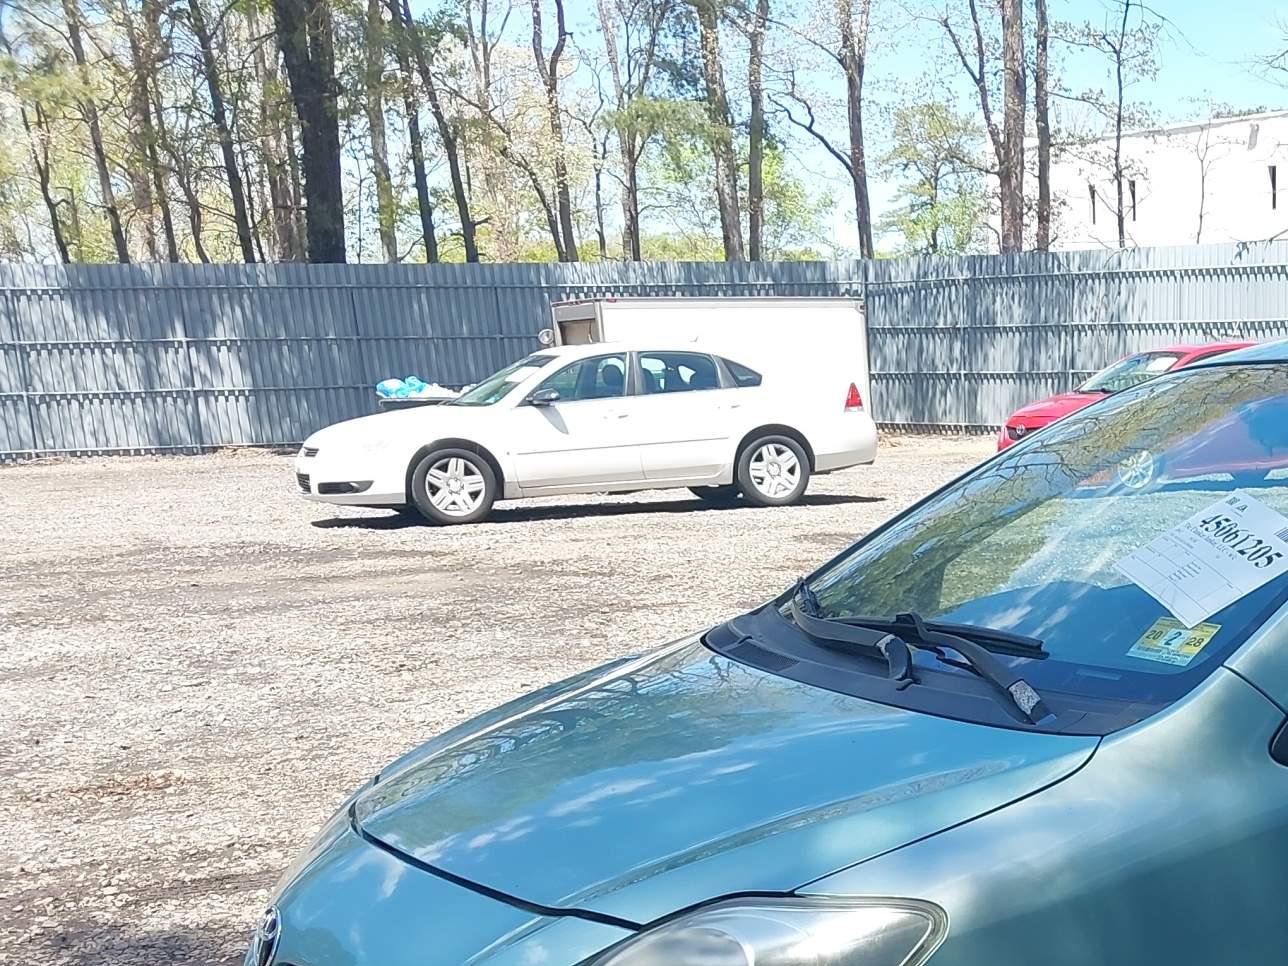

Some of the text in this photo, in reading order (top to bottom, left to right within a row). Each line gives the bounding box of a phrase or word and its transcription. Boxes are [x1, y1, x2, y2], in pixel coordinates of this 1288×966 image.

[1199, 514, 1284, 569] 45061205
[1145, 629, 1205, 648] 20 2 28
